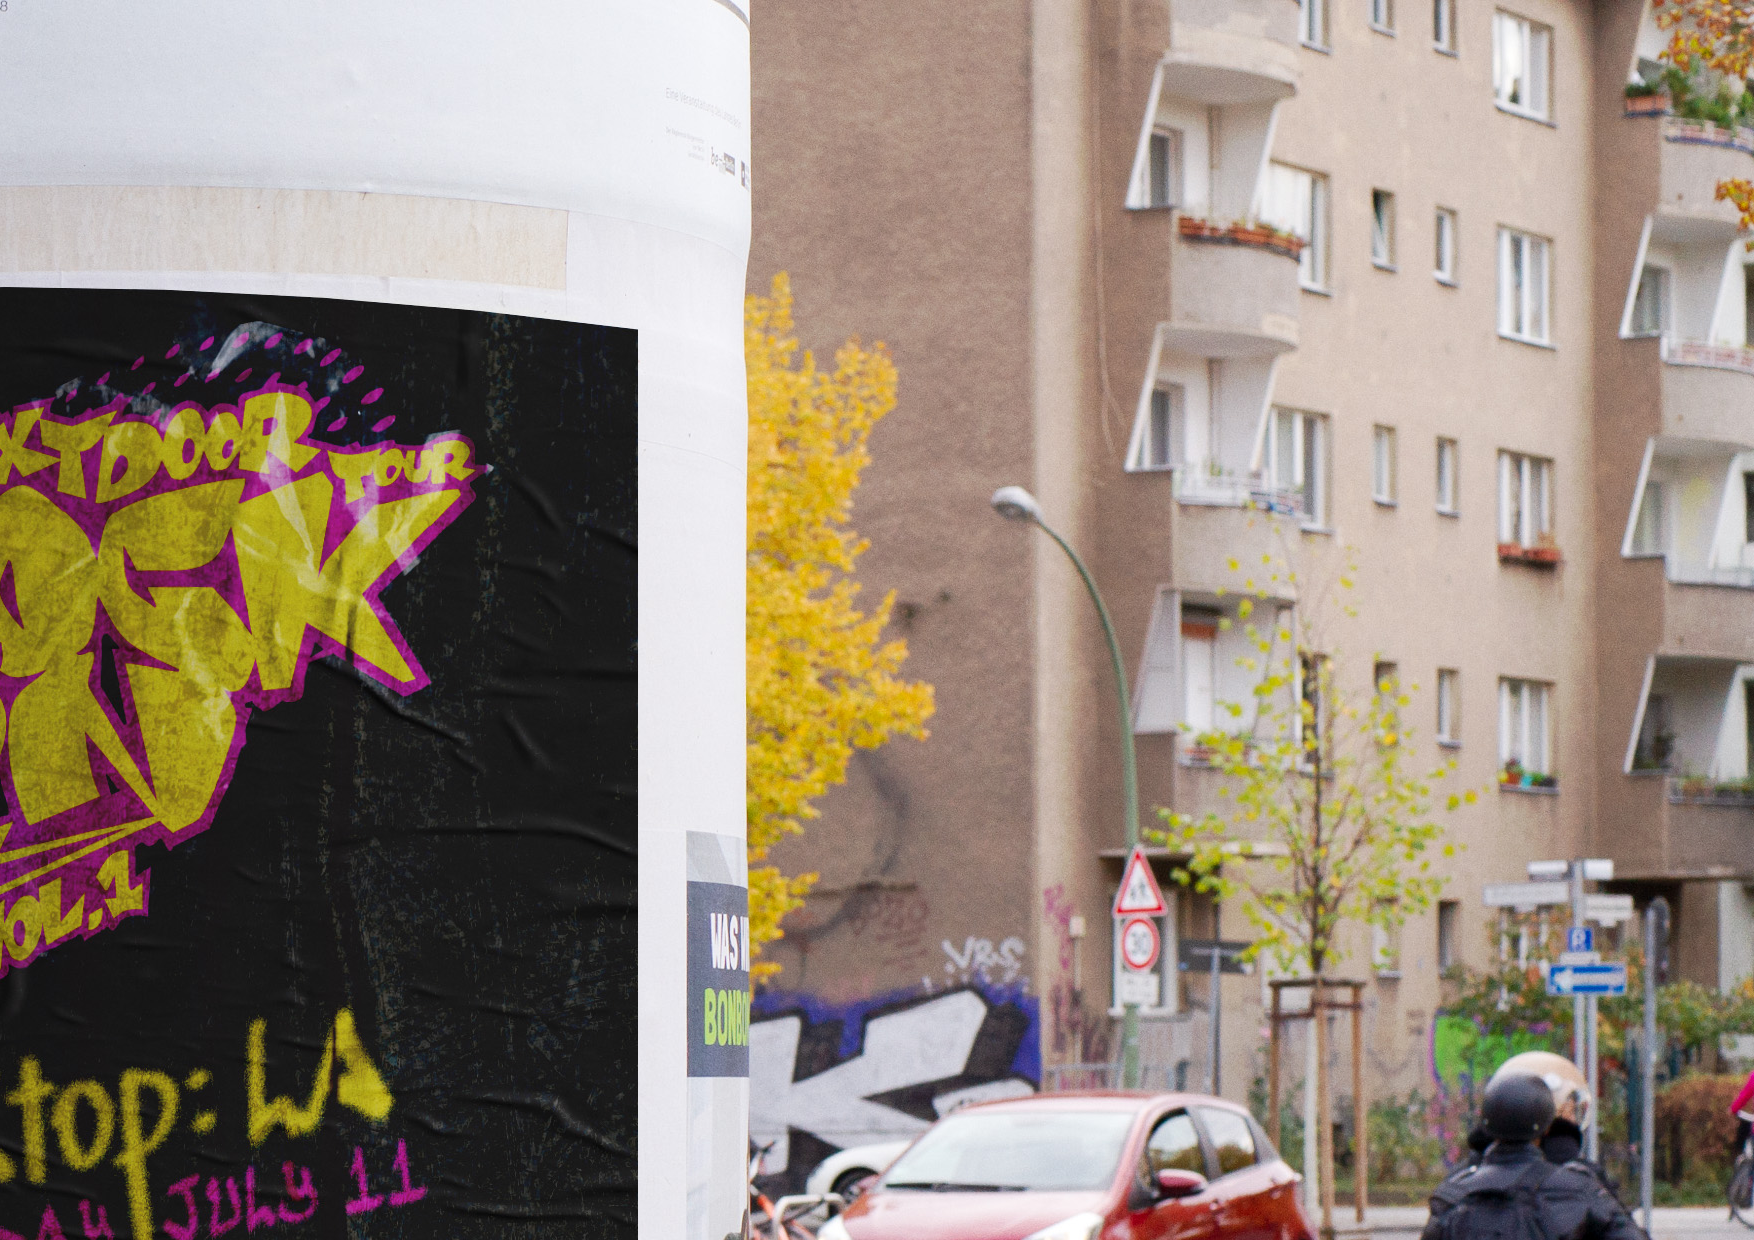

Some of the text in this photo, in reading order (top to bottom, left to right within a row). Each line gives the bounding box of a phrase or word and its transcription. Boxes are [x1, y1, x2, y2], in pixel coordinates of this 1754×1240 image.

[329, 439, 477, 503] TOUR
[710, 912, 738, 970] WAS
[246, 1006, 395, 1145] LA
[344, 1136, 428, 1216] 11
